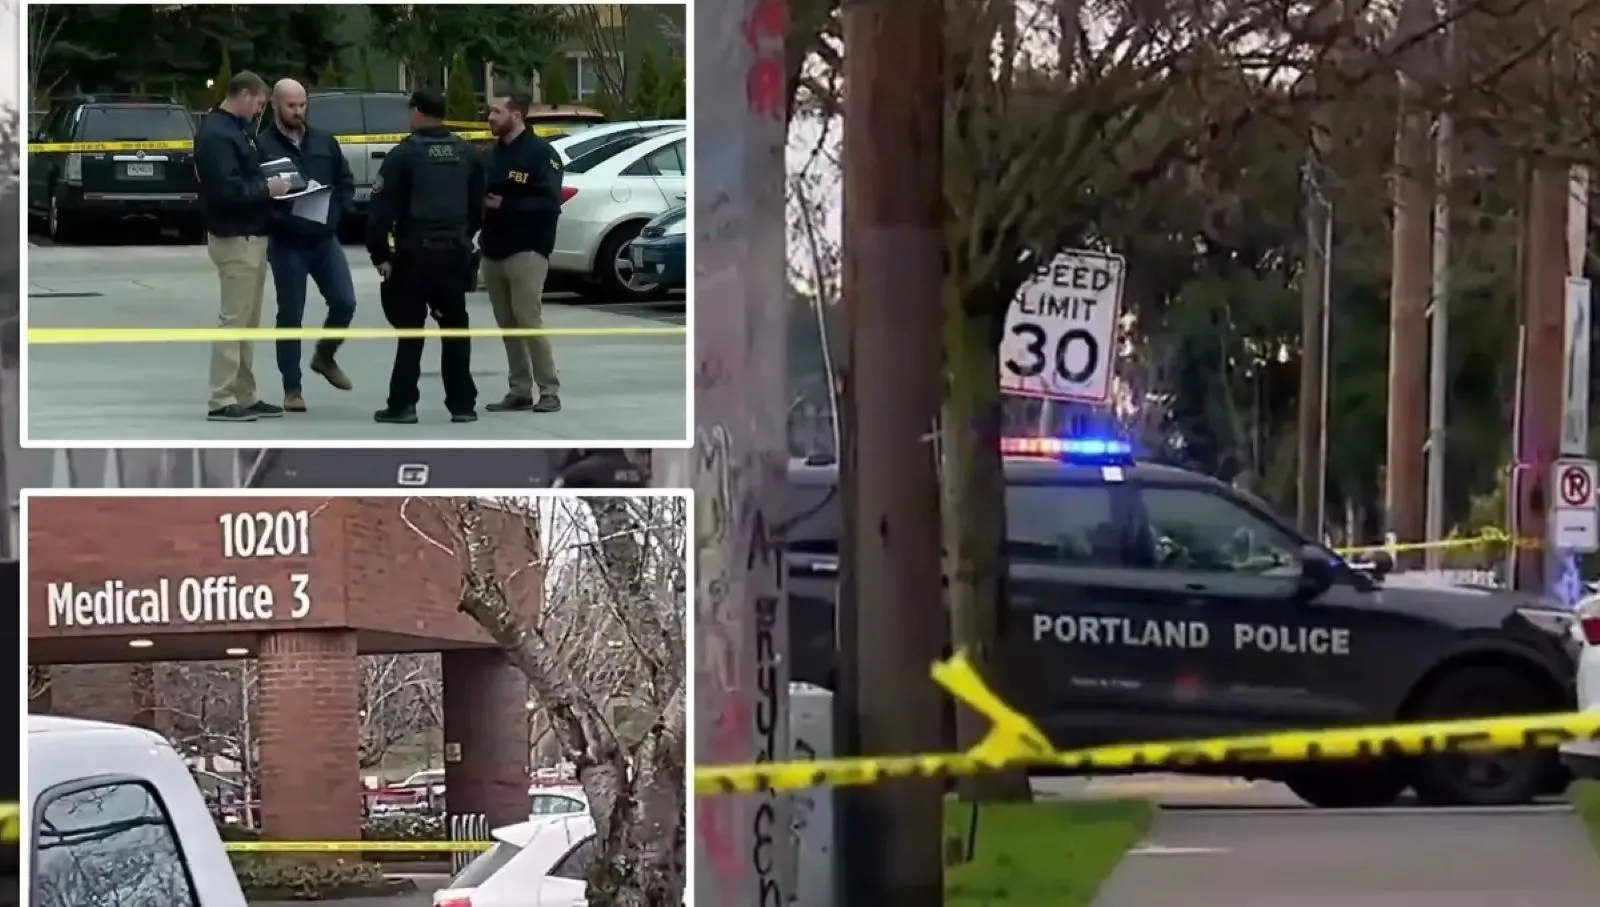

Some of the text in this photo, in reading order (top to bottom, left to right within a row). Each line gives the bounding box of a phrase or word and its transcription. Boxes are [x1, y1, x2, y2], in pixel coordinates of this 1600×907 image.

[508, 170, 529, 184] FBI
[1033, 264, 1112, 292] PEED
[1019, 292, 1098, 321] LIMIT
[1005, 323, 1098, 383] 30
[220, 511, 309, 558] 10201
[48, 573, 310, 627] Medical Office 3
[1033, 614, 1351, 655] PORTLAND POLICE
